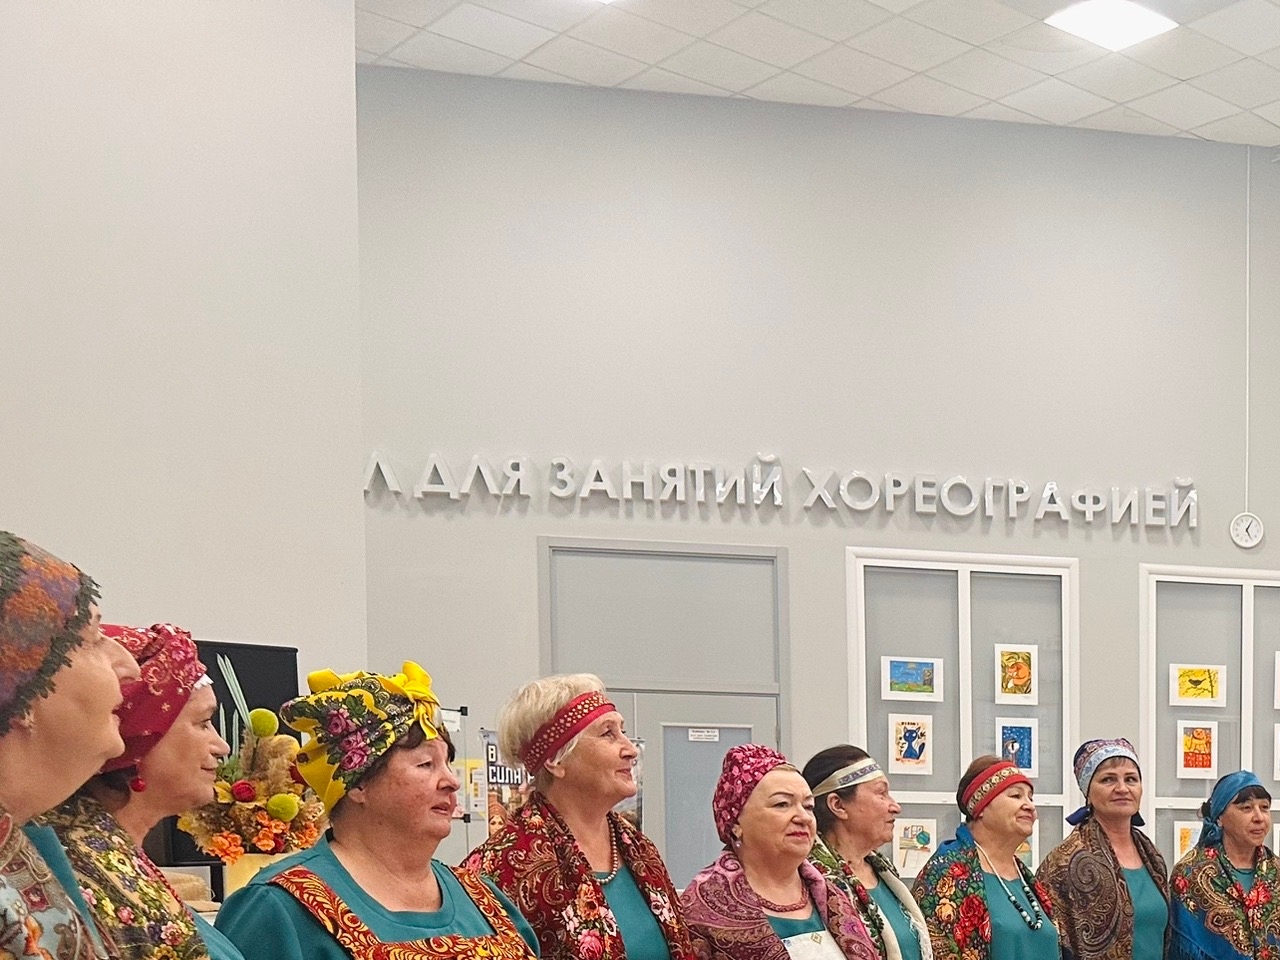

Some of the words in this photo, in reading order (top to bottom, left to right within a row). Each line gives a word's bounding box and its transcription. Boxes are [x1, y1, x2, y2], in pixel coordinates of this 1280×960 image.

[413, 452, 531, 500] ДЛЯ
[549, 452, 784, 506] ЗАНЯТИЙ
[801, 466, 1198, 528] ХОРЕОГРАФИЕЙ
